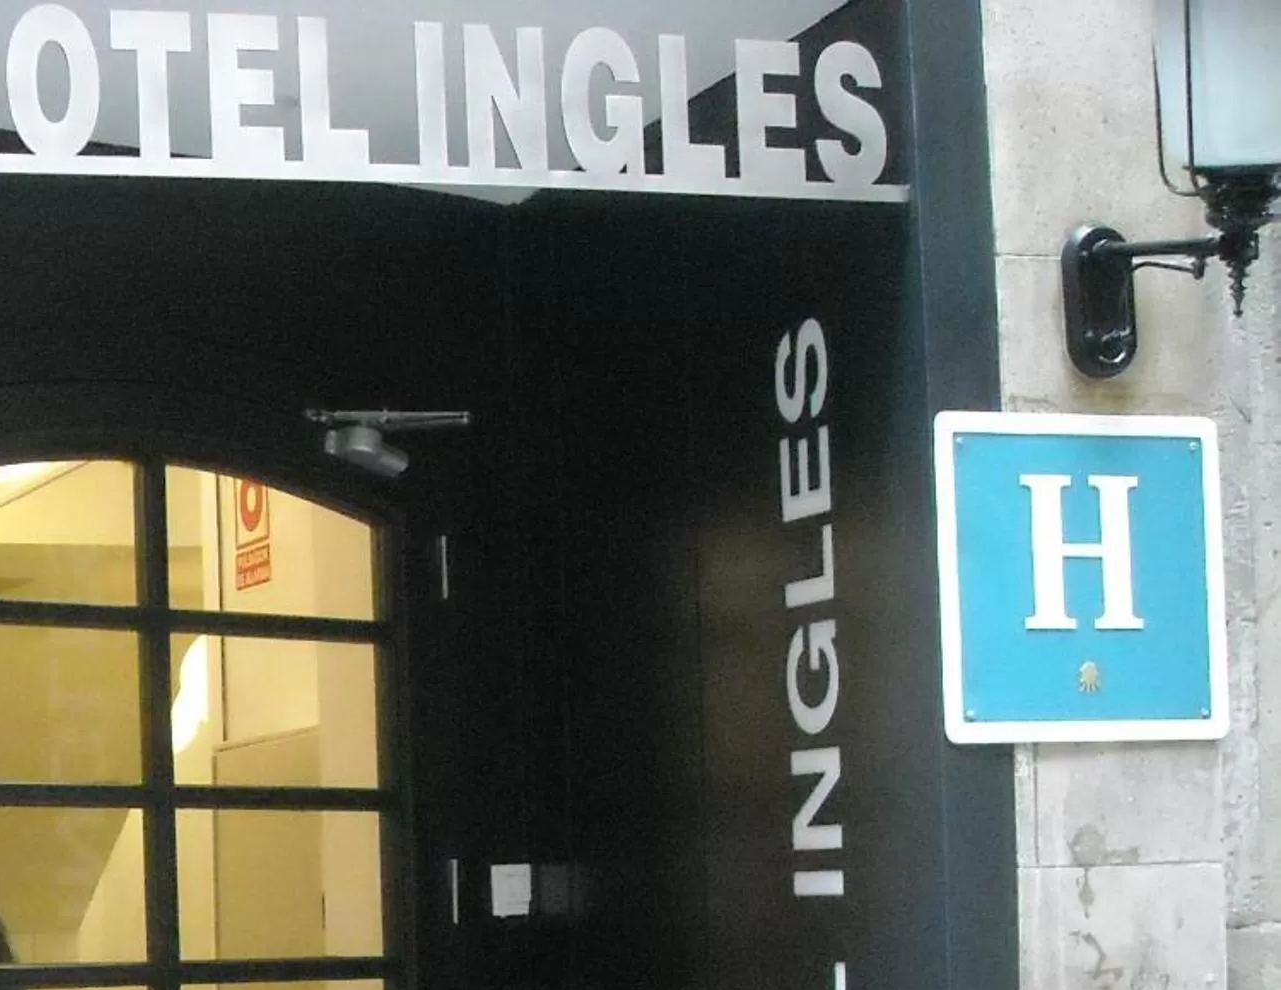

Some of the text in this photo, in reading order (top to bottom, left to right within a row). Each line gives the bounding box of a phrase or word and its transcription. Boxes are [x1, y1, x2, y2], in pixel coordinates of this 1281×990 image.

[414, 21, 888, 186] INGLES
[775, 317, 845, 896] INGLES
[1019, 473, 1145, 630] H
